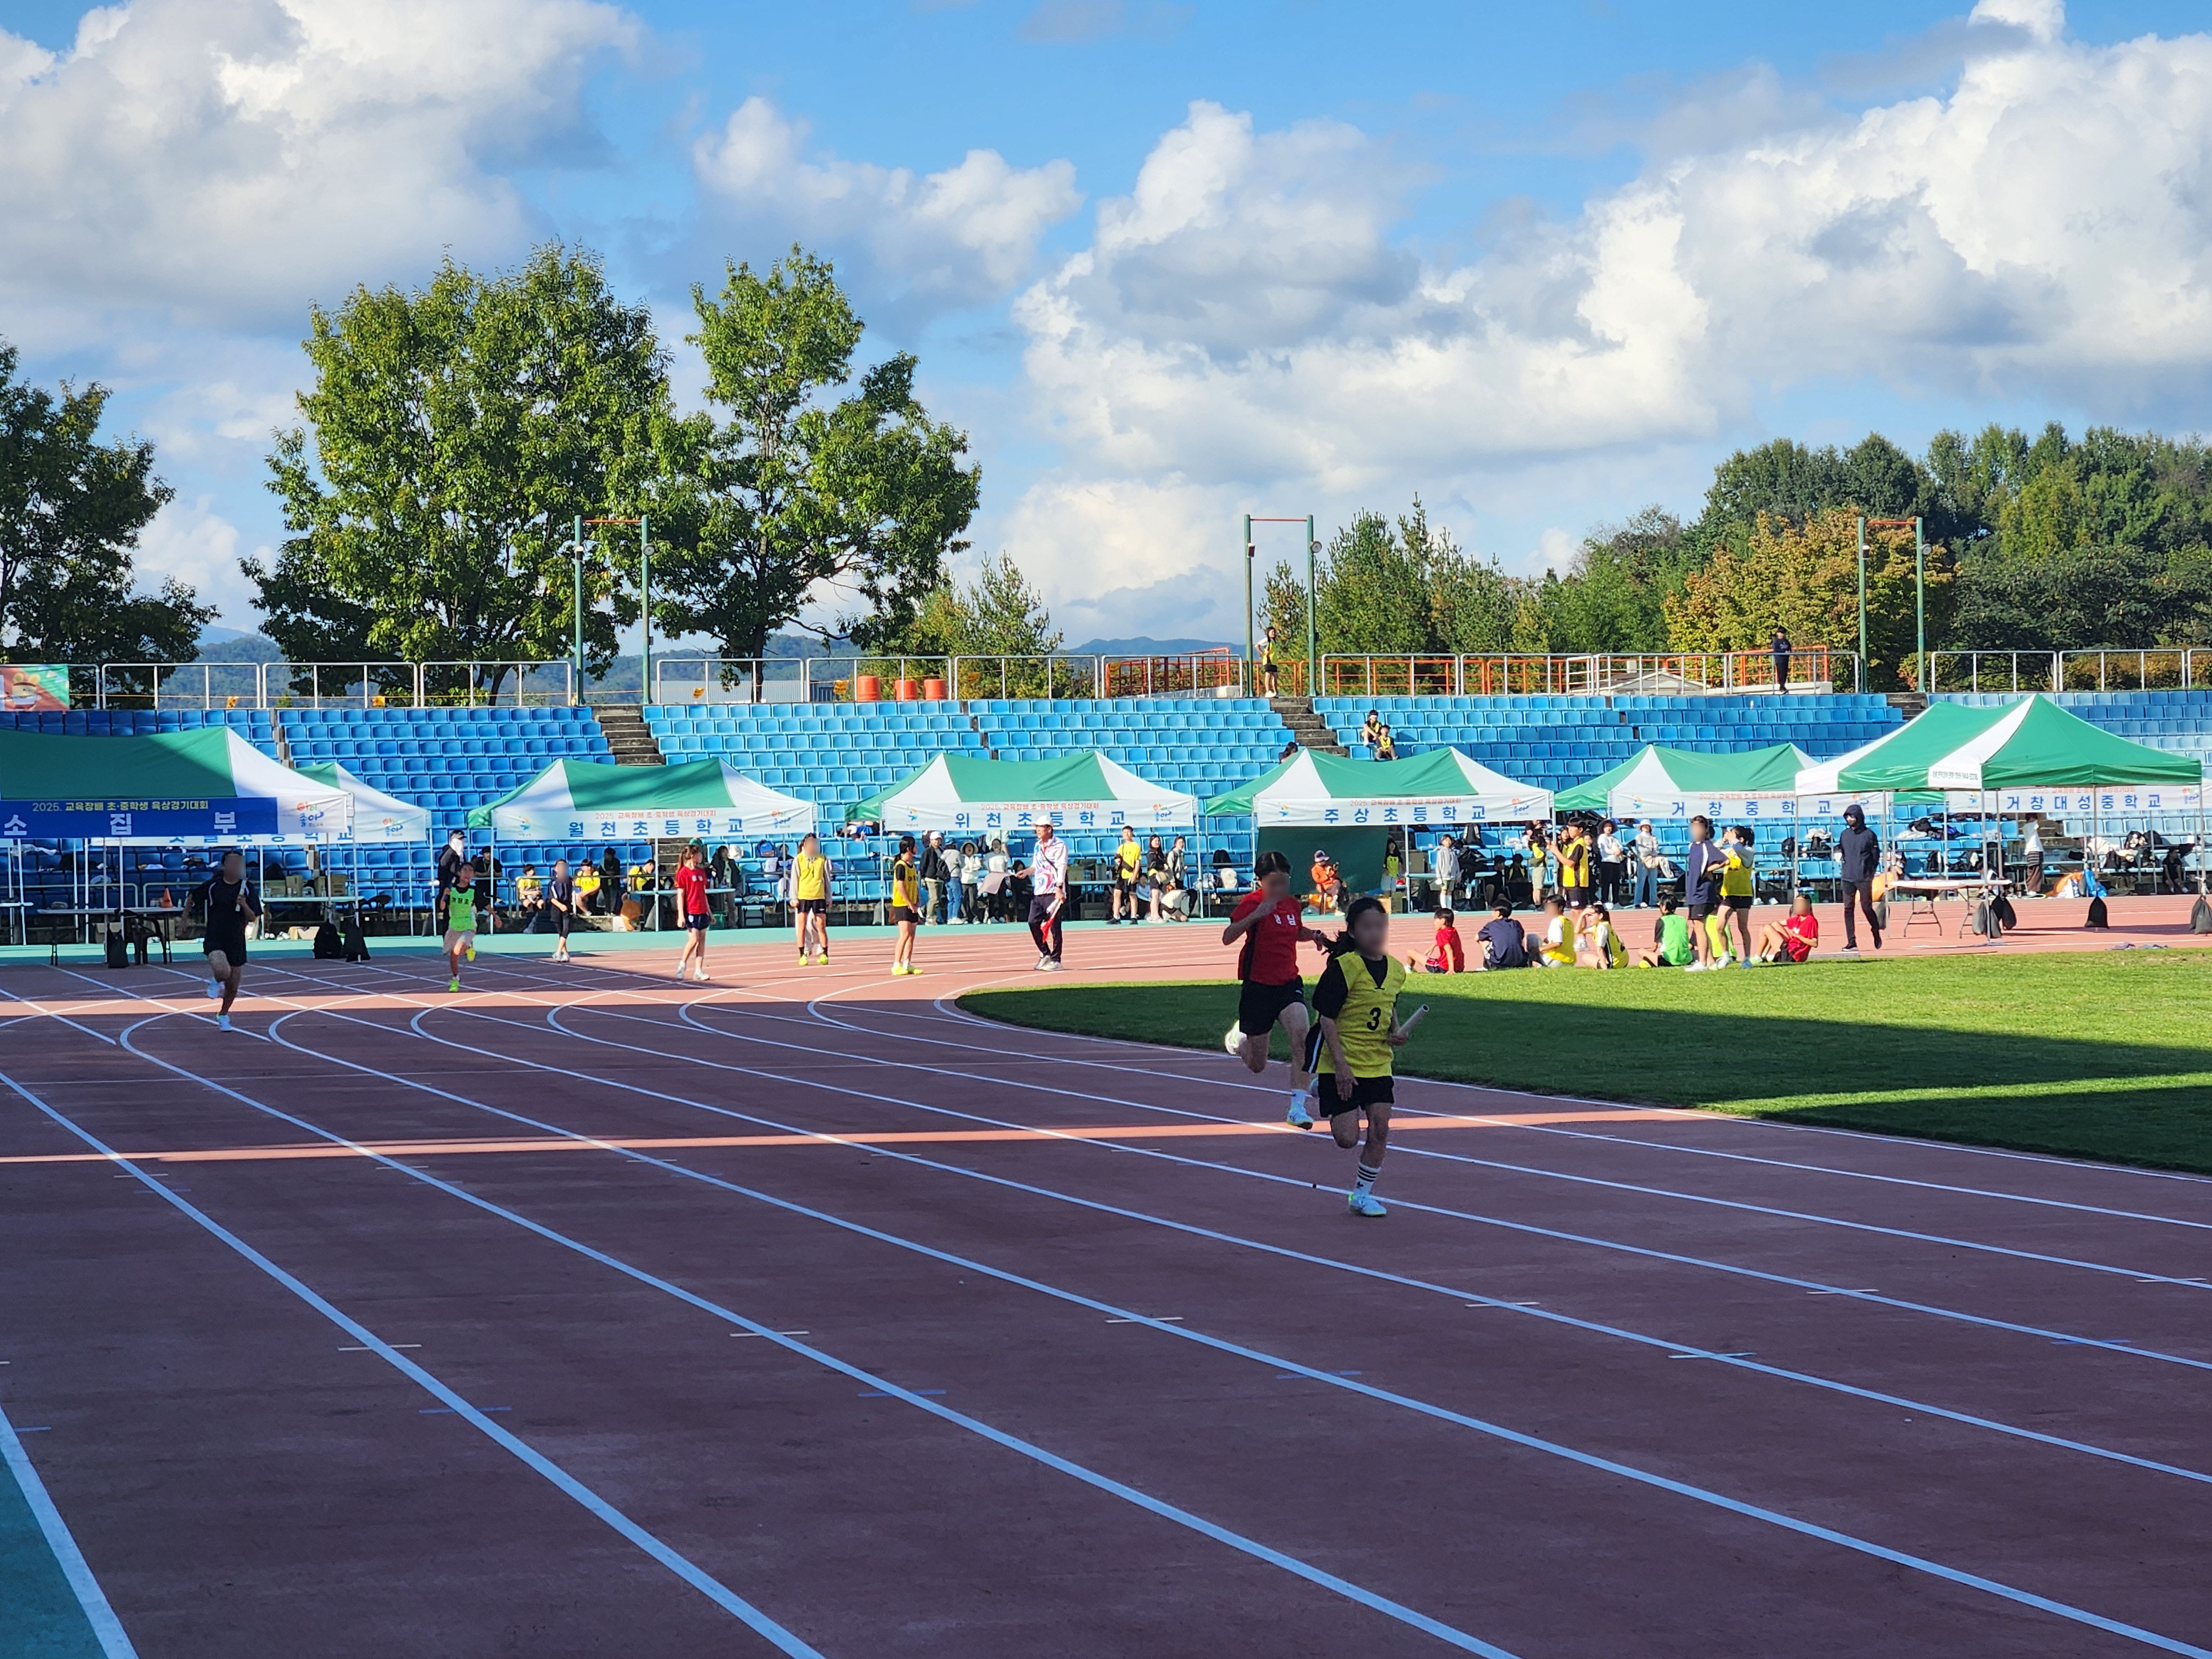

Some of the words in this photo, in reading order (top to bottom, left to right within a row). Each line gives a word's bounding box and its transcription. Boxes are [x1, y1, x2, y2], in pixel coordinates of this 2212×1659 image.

[32, 802, 62, 812] 2025.
[65, 802, 104, 811] 교육장배
[107, 801, 149, 811] 초·중학생
[152, 800, 208, 811] 육상경기대회
[1672, 800, 1832, 816] 거창중학교
[2007, 794, 2161, 810] 거창대성중학교
[955, 810, 1126, 828] 위천초등학교
[1324, 805, 1486, 824] 주상초등학교
[569, 818, 743, 837] 월천초등학교
[1366, 1007, 1381, 1031] 3
